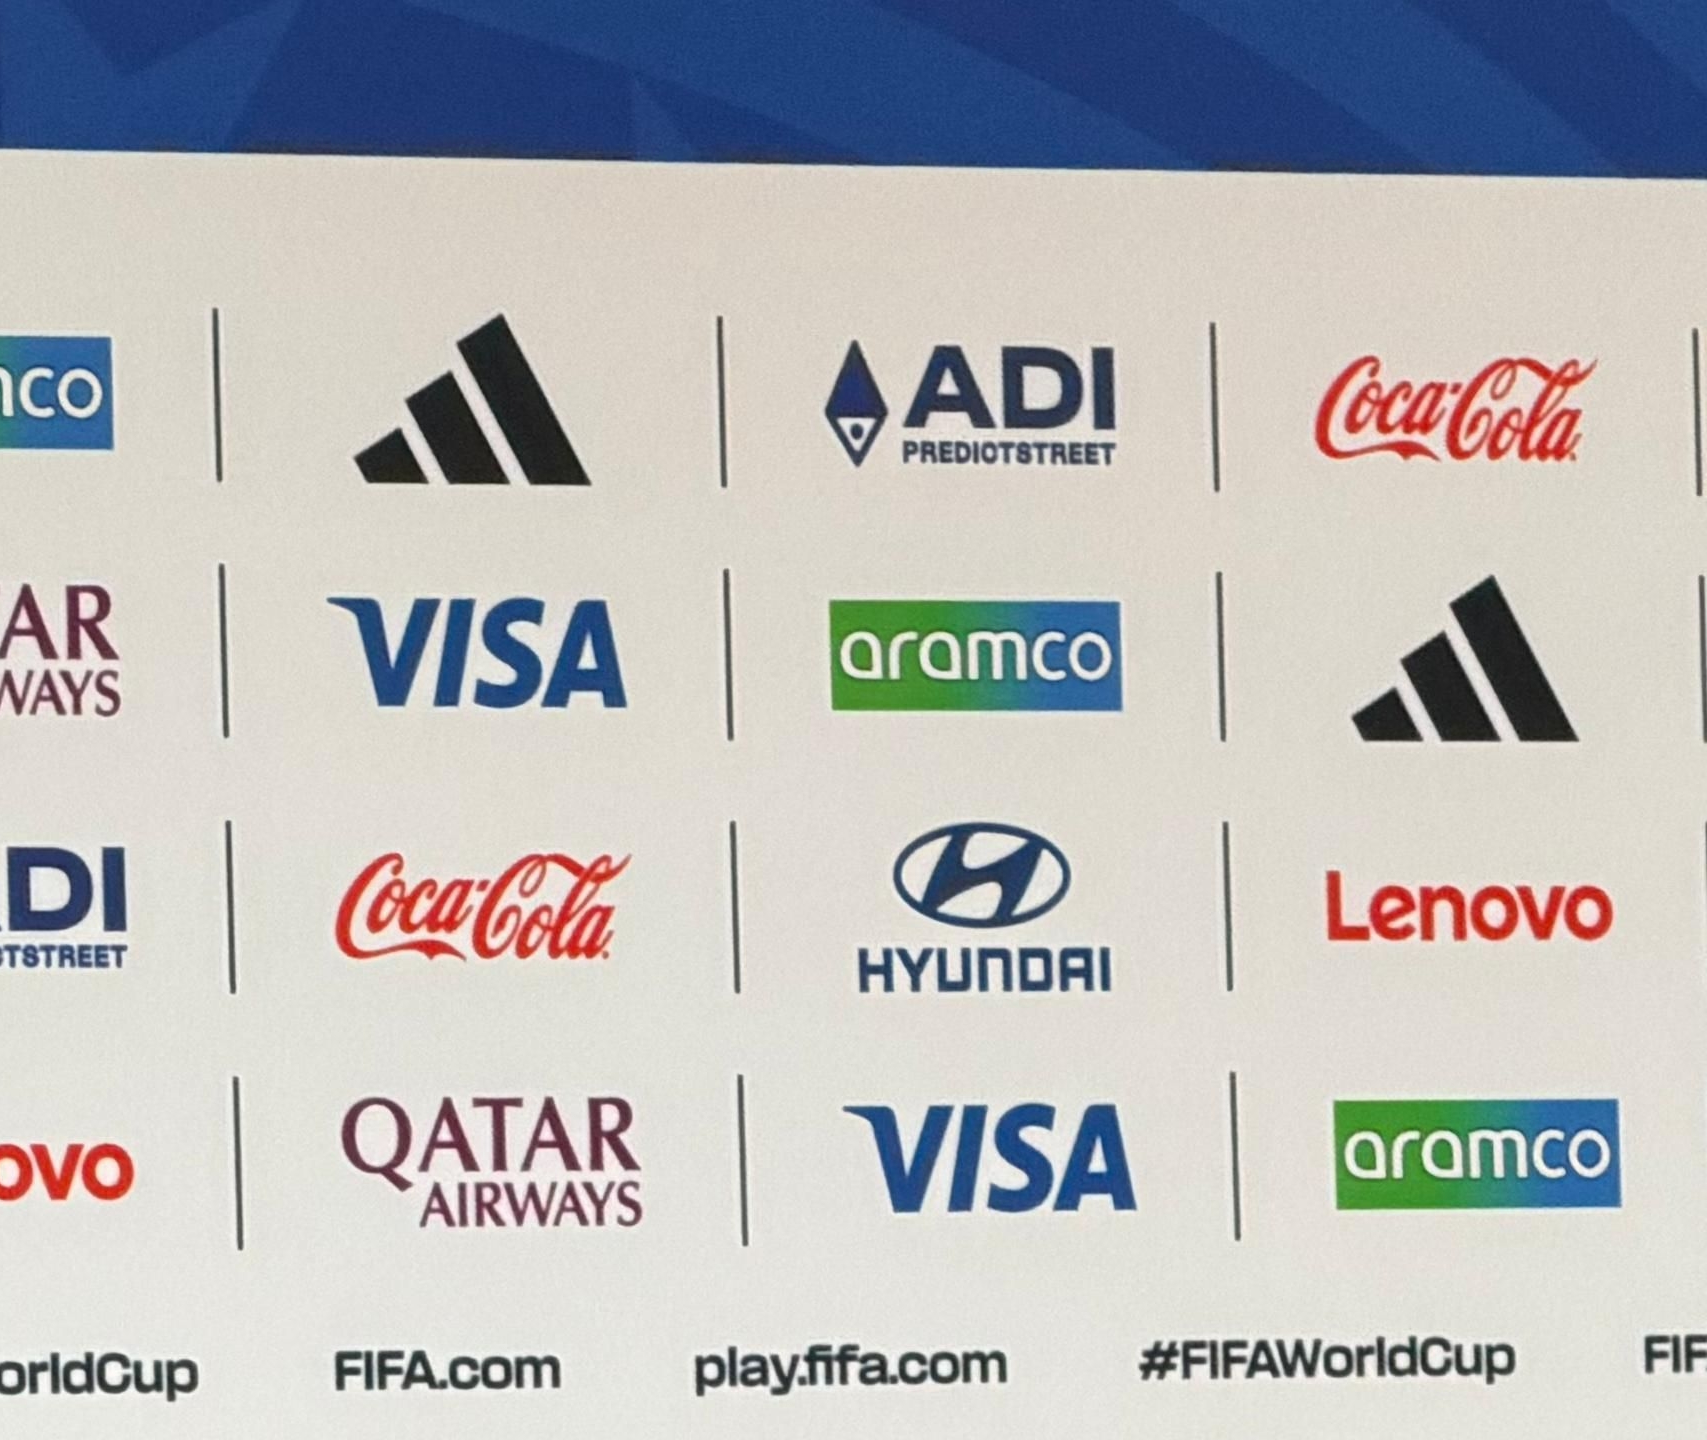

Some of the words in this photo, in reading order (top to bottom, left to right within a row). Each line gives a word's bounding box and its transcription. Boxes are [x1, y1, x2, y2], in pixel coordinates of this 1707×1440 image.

[903, 345, 1115, 430] ADI
[1315, 356, 1594, 461] Coca-Cola
[903, 441, 1116, 465] PREDICTSTREET
[327, 598, 627, 708] VISA
[841, 632, 1111, 680] aramco
[336, 853, 629, 960] Coca-Cola
[1327, 871, 1613, 941] Lenovo
[859, 947, 1110, 992] HYUNDAI
[342, 1097, 640, 1200] QATAR
[844, 1103, 1136, 1212] VISA
[1345, 1130, 1610, 1178] aramco
[420, 1181, 642, 1227] AIRWAYS
[335, 1350, 560, 1390] FIFA.com
[695, 1344, 1007, 1396] play.fifa.com
[1139, 1336, 1515, 1384] #FIFAWorldCup
